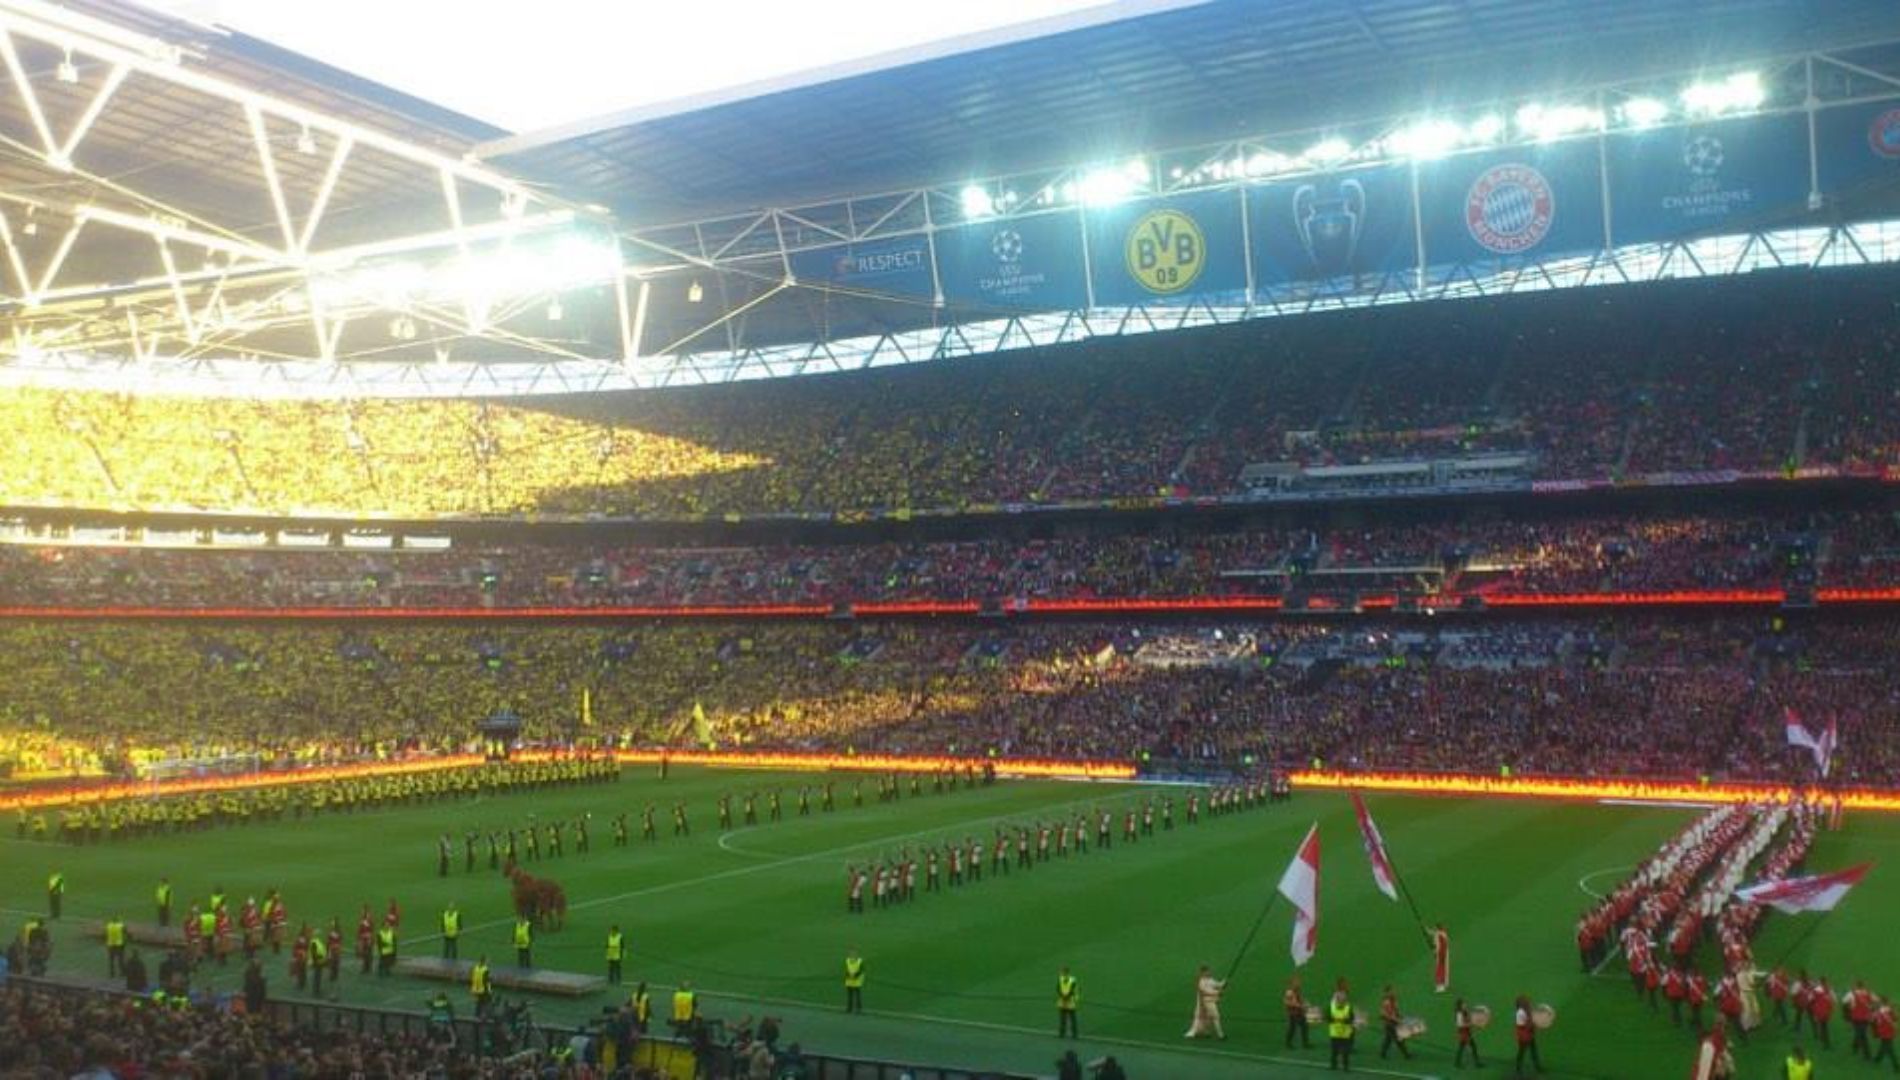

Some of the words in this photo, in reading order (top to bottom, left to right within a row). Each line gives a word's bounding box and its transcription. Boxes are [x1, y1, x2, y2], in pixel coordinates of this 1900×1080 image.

[1137, 219, 1196, 270] BVB
[858, 250, 922, 272] RESPECT
[1156, 266, 1178, 284] 09
